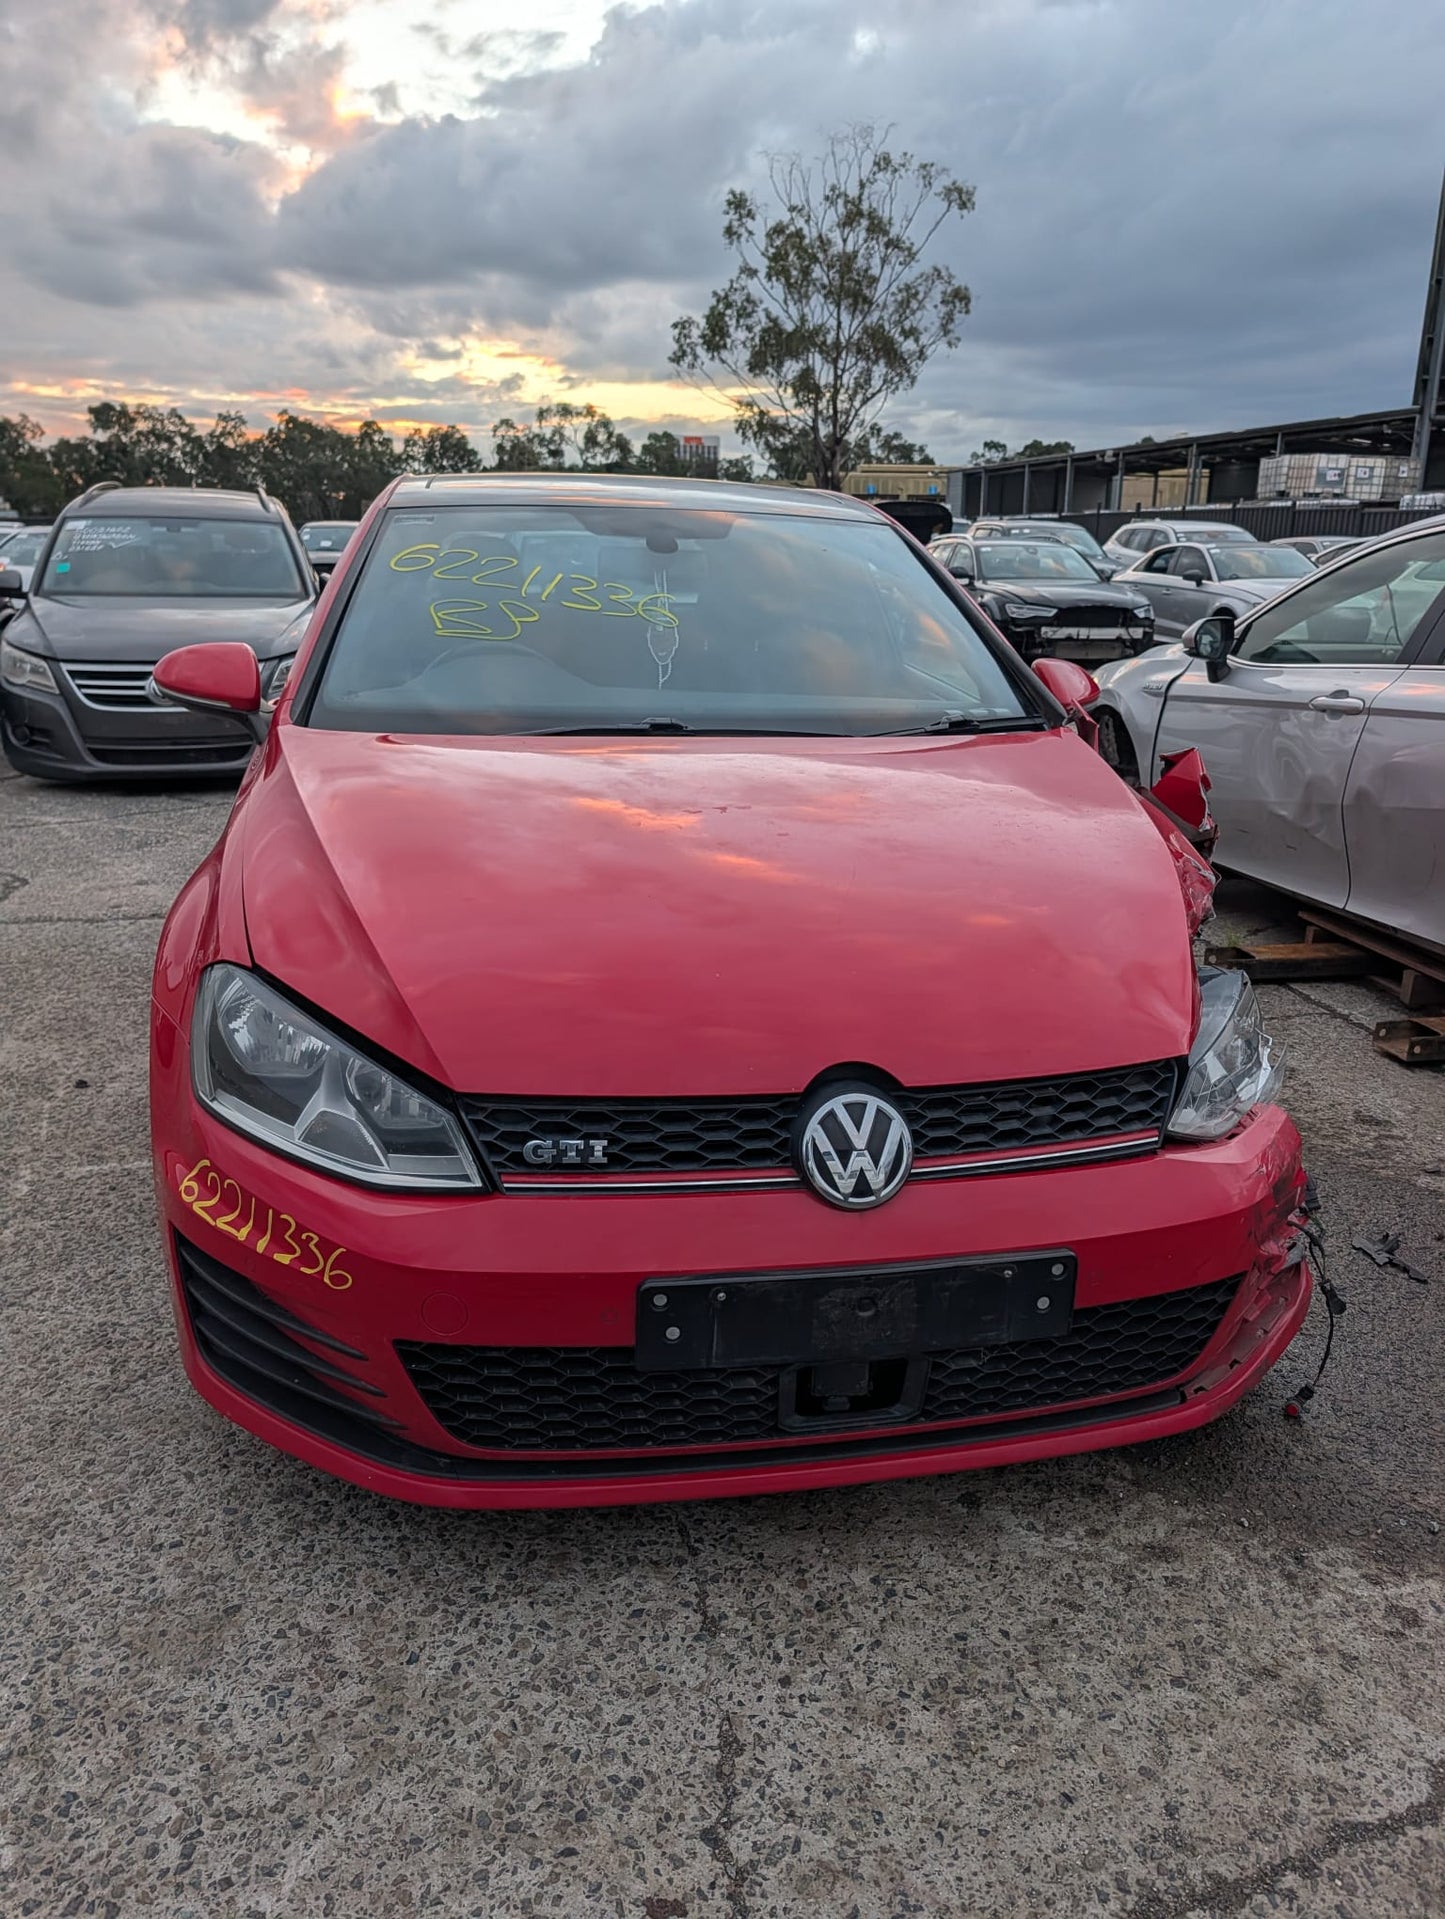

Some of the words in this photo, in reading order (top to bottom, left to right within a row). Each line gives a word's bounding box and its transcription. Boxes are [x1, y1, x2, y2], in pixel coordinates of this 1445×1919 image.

[390, 544, 679, 628] 62211336
[522, 1139, 609, 1165] GTI
[178, 1159, 353, 1290] 62211336
